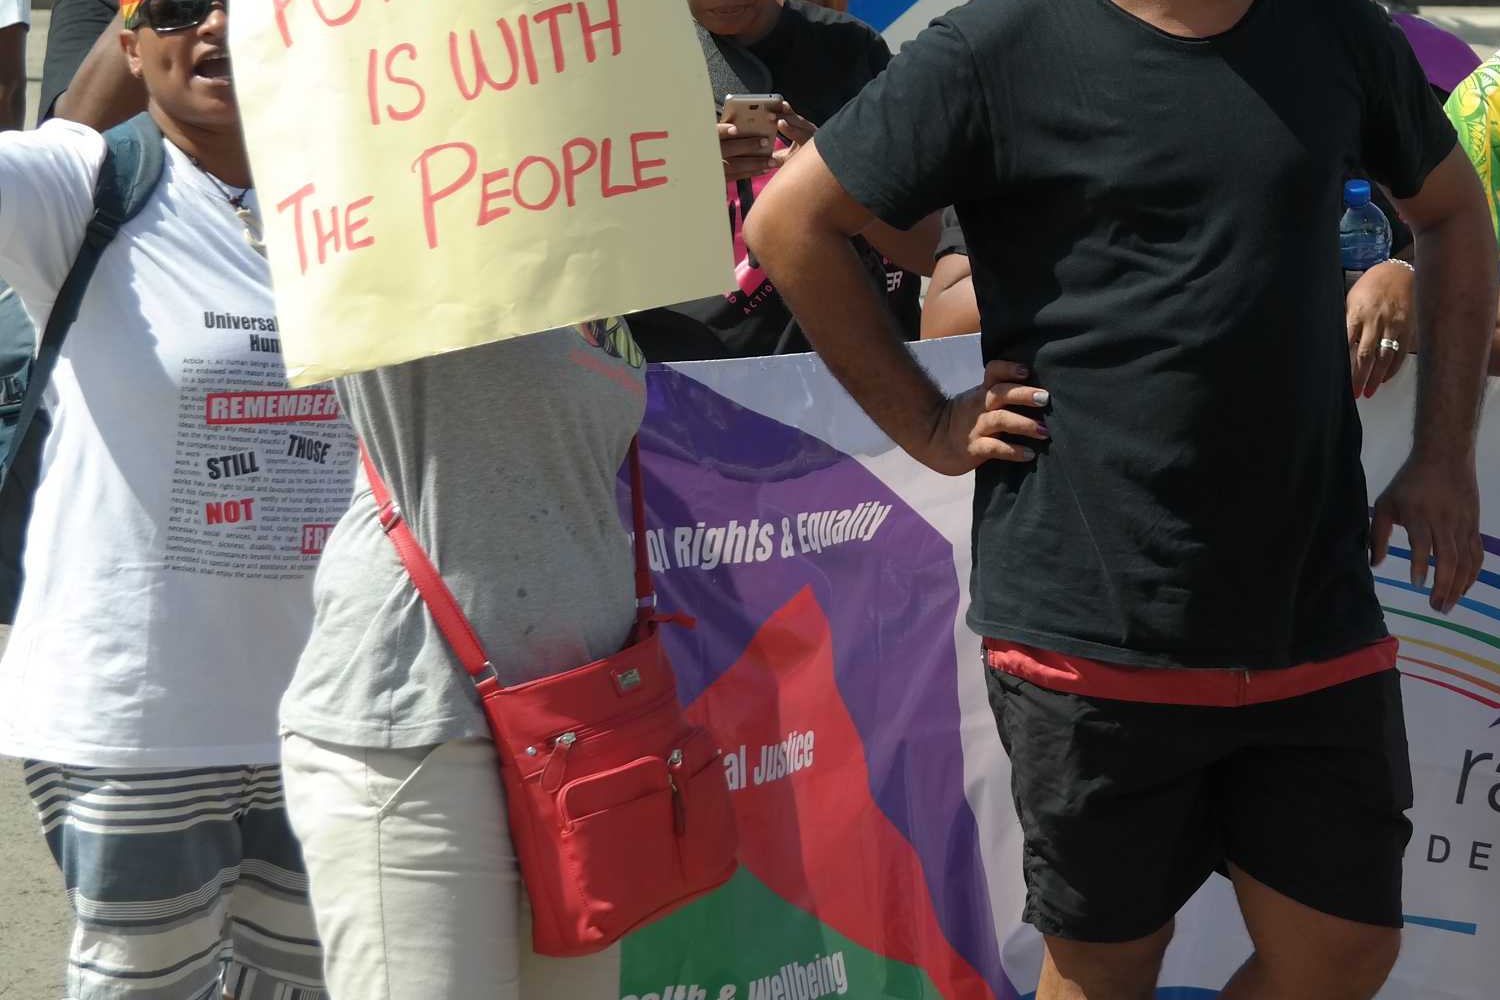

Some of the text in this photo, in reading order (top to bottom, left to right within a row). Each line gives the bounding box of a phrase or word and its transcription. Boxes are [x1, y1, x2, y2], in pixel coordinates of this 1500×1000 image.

[367, 42, 426, 125] IS
[277, 131, 669, 276] THE PEOPLE
[204, 311, 279, 332] Universal
[211, 394, 339, 418] REMEMBER
[287, 434, 332, 464] THOSE
[207, 451, 259, 480] STILL
[206, 498, 255, 525] NOT
[304, 526, 331, 549] FR
[673, 519, 775, 570] Rights
[780, 517, 795, 559] &
[797, 500, 892, 554] Equality
[718, 730, 815, 791] al Justice
